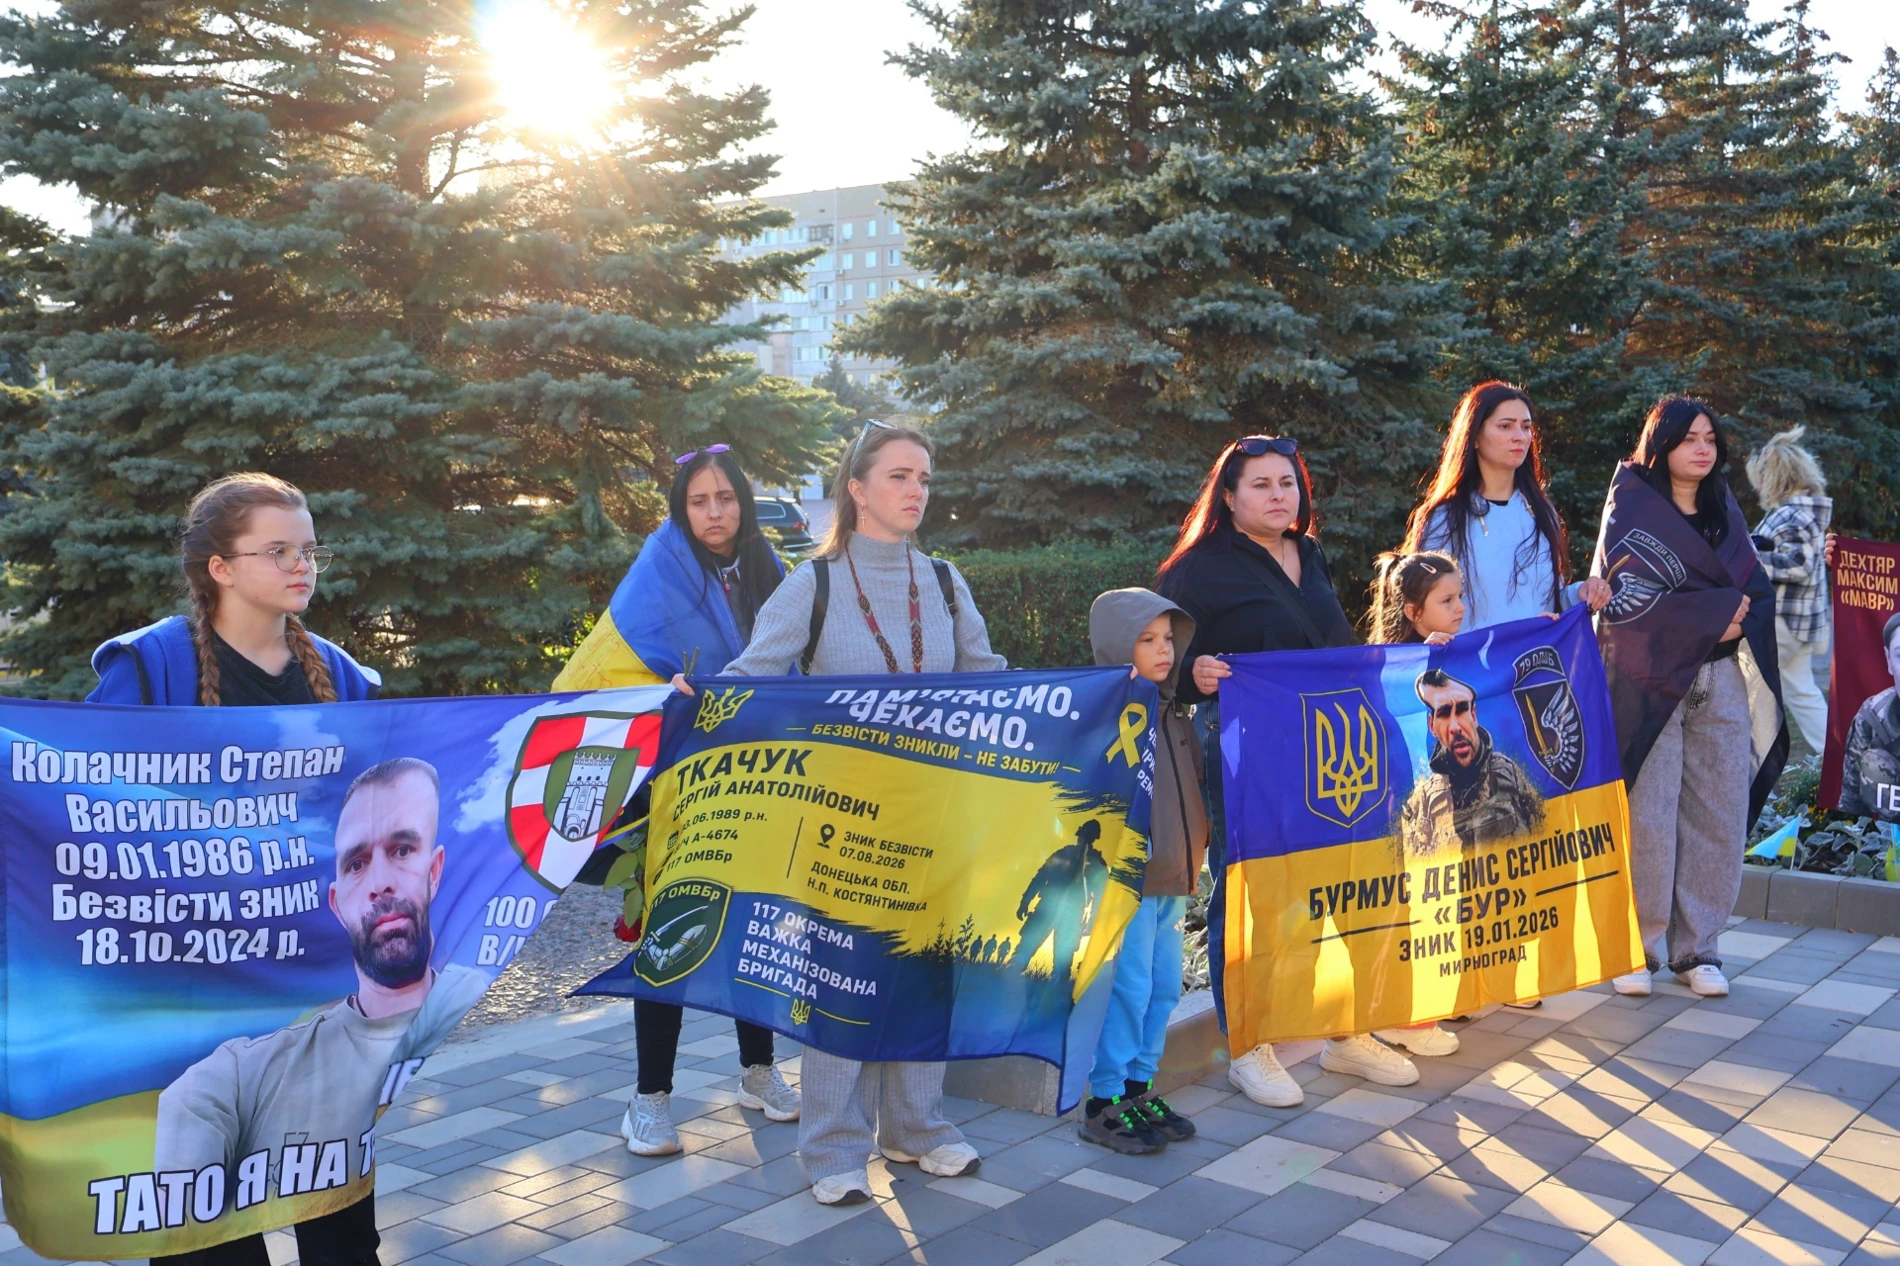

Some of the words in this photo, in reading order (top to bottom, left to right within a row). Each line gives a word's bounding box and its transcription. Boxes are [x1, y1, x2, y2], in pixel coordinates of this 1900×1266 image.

[1633, 533, 1668, 556] ЗАВЖДИ
[1839, 551, 1895, 575] ДЕХТЯР
[1837, 569, 1898, 594] МАКСИМ
[1841, 590, 1895, 611] «МАВР»
[1520, 658, 1531, 676] 79
[849, 701, 1034, 752] ЧЕКАЄМО.
[11, 741, 212, 784] Колачник
[220, 745, 345, 783] Степан
[811, 723, 890, 746] БЕЗВІСТИ
[894, 734, 960, 761] ЗНИКЛИ
[976, 751, 998, 767] НЕ
[1000, 755, 1060, 776] ЗАБУТИ!
[677, 748, 813, 796] ТКАЧУК
[65, 792, 298, 833] Васильович
[673, 780, 721, 822] СЕРГІЙ
[725, 780, 880, 821] АНАТОЛІЙОВИЧ
[744, 811, 767, 822] р.н.
[692, 829, 738, 844] А-4674
[843, 831, 876, 848] ЗНИК
[879, 840, 934, 859] БЕЗВІСТИ
[55, 836, 253, 880] 09.01.1986
[259, 836, 315, 875] р.н.
[684, 849, 733, 864] ОМВБр
[839, 846, 906, 869] 07.08.2026
[1309, 871, 1412, 921] БУРМУС
[1422, 853, 1500, 904] ДЕНИС
[1506, 822, 1616, 880] СЕРГІЙОВИЧ
[668, 884, 721, 901] ОМВБр
[807, 877, 829, 895] Н.П.
[833, 887, 927, 912] КОСТЯНТИНІВКА
[810, 861, 878, 888] ДОНЕЦЬКА
[882, 879, 910, 894] ОБЛ.
[51, 883, 233, 924] Безвісти
[239, 879, 320, 919] зник
[484, 895, 537, 929] 100
[1434, 887, 1528, 925] «БУР»
[747, 920, 811, 954] ВАЖКА
[752, 901, 780, 920] 117
[784, 911, 854, 950] ОКРЕМА
[1399, 930, 1456, 962] ЗНИК
[1465, 906, 1559, 949] 19.01.2026
[76, 927, 269, 965] 18.10.2024
[275, 927, 305, 959] р.
[1439, 944, 1527, 977] МИРНОГРАД
[737, 958, 818, 999] БРИГАДА
[742, 939, 877, 996] МЕХАНІЗОВАНА
[88, 1163, 225, 1235] ТАТО
[236, 1149, 270, 1211] Я
[278, 1139, 348, 1198] НА
